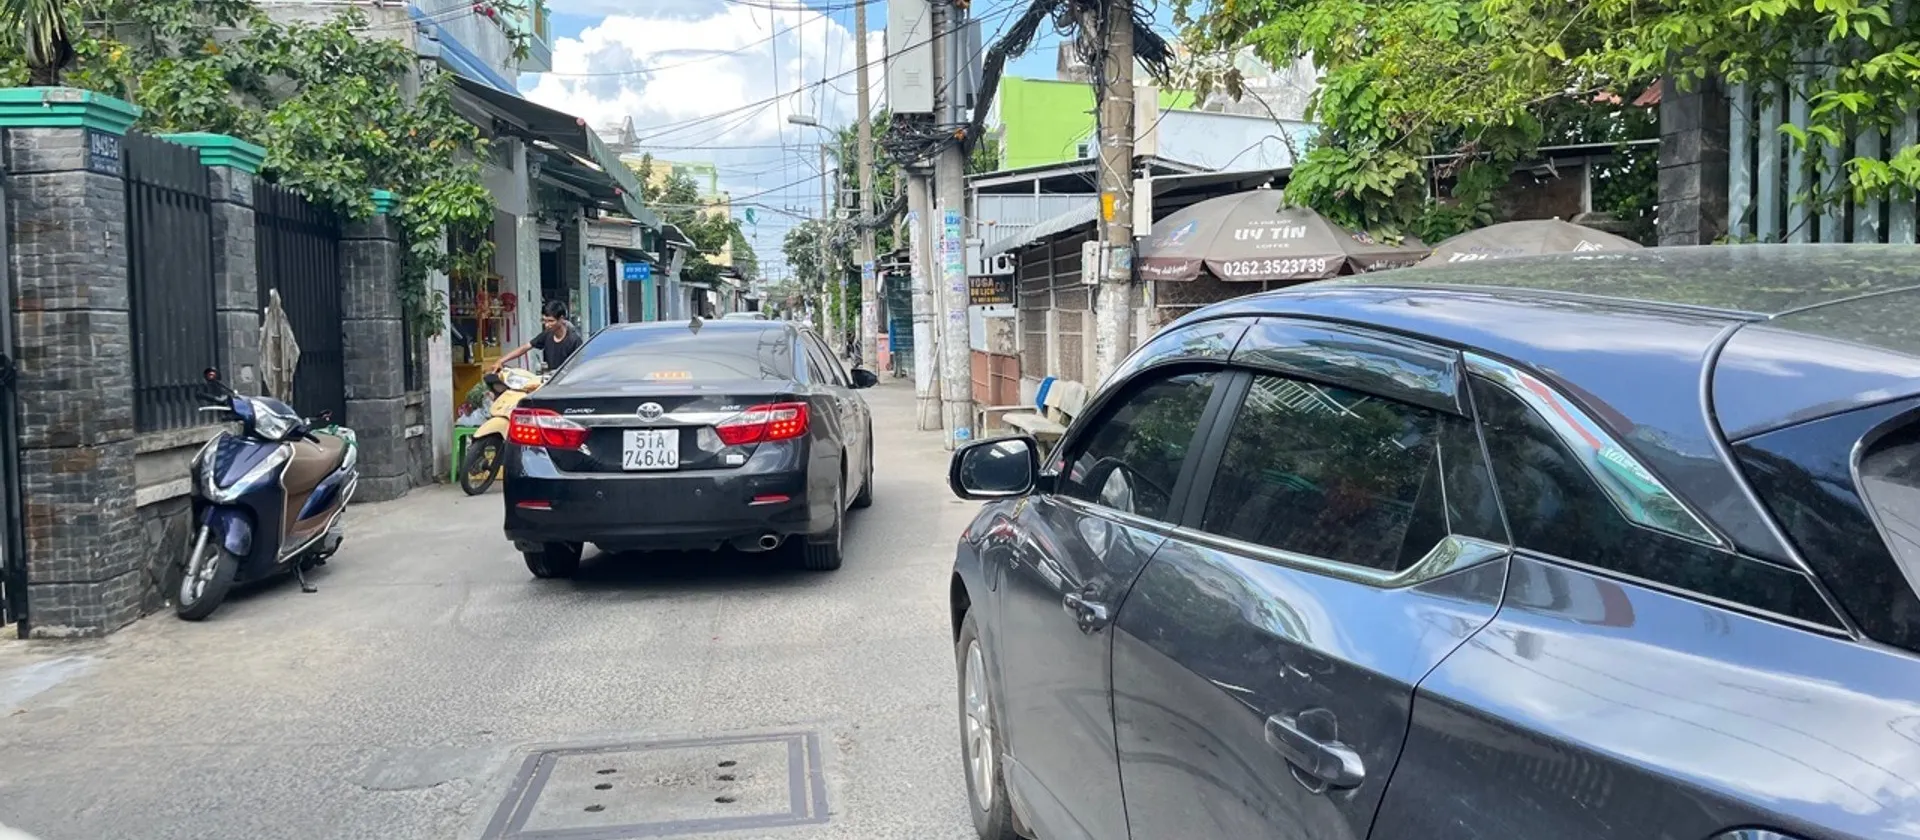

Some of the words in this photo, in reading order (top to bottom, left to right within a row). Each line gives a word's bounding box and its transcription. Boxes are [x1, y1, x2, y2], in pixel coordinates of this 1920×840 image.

[1223, 258, 1326, 276] 0262.3523739
[636, 432, 665, 449] 51A
[625, 450, 676, 466] 746.40
